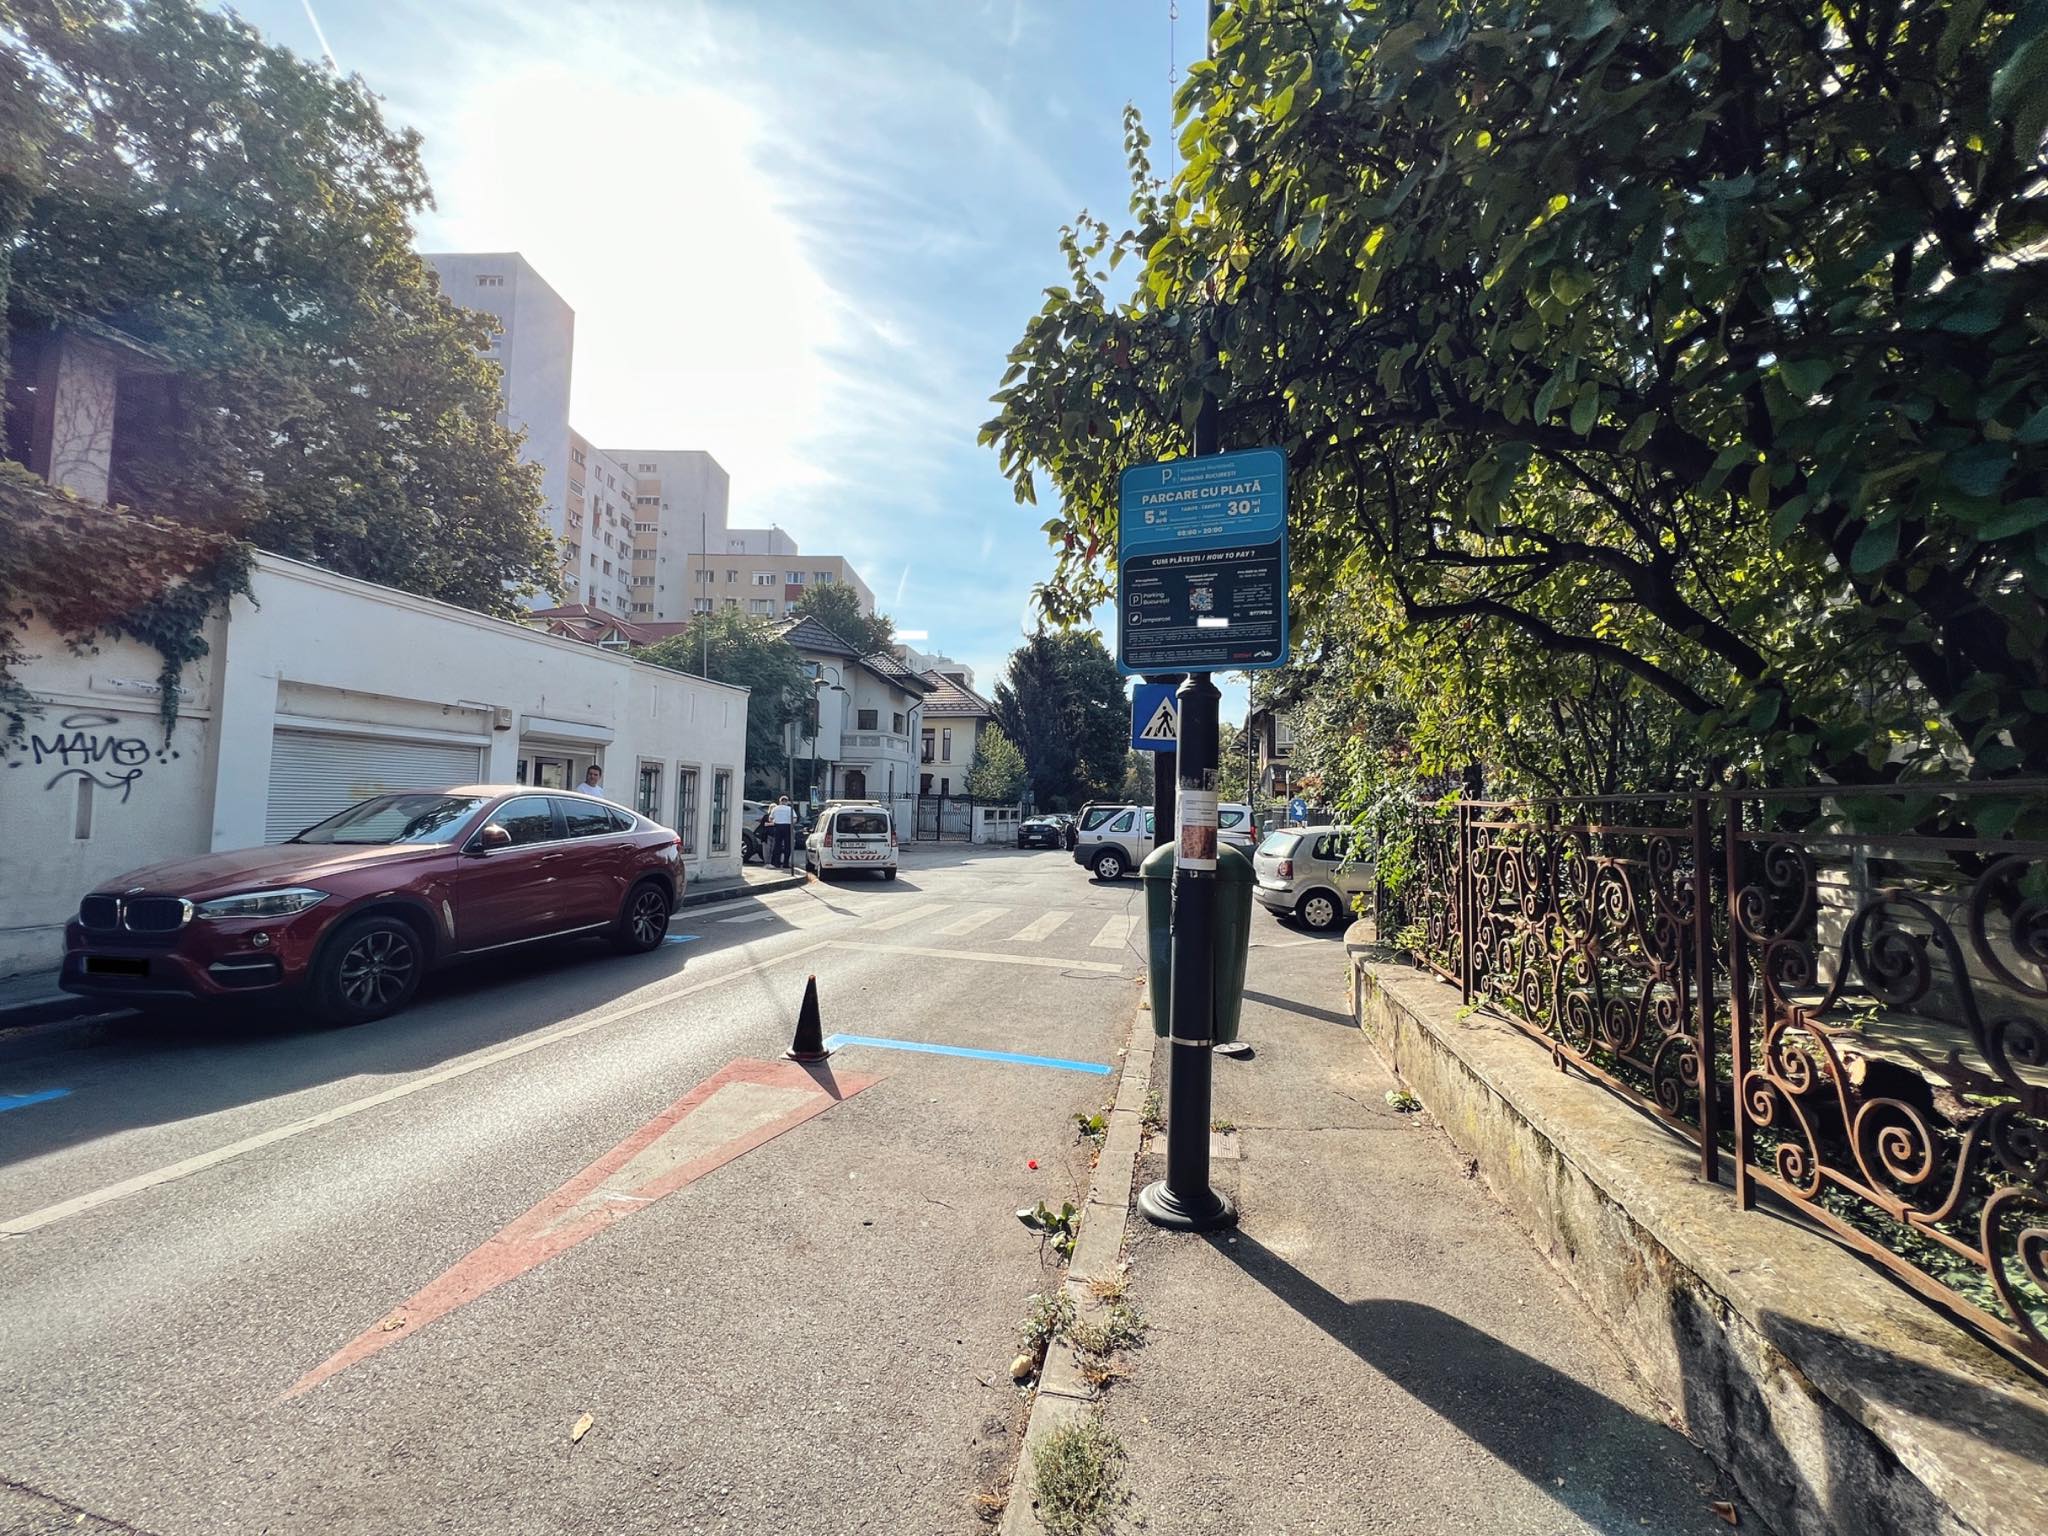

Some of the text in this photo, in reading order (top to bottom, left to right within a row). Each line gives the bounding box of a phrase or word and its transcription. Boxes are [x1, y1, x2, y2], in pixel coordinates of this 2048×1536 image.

[1142, 479, 1262, 505] PARCARE CU PLATĂ
[1227, 500, 1251, 516] 30
[1144, 510, 1155, 524] 5
[1203, 526, 1223, 534] 20:00
[1152, 558, 1168, 566] CUM
[1206, 553, 1224, 561] HOW
[1235, 550, 1250, 558] PAY
